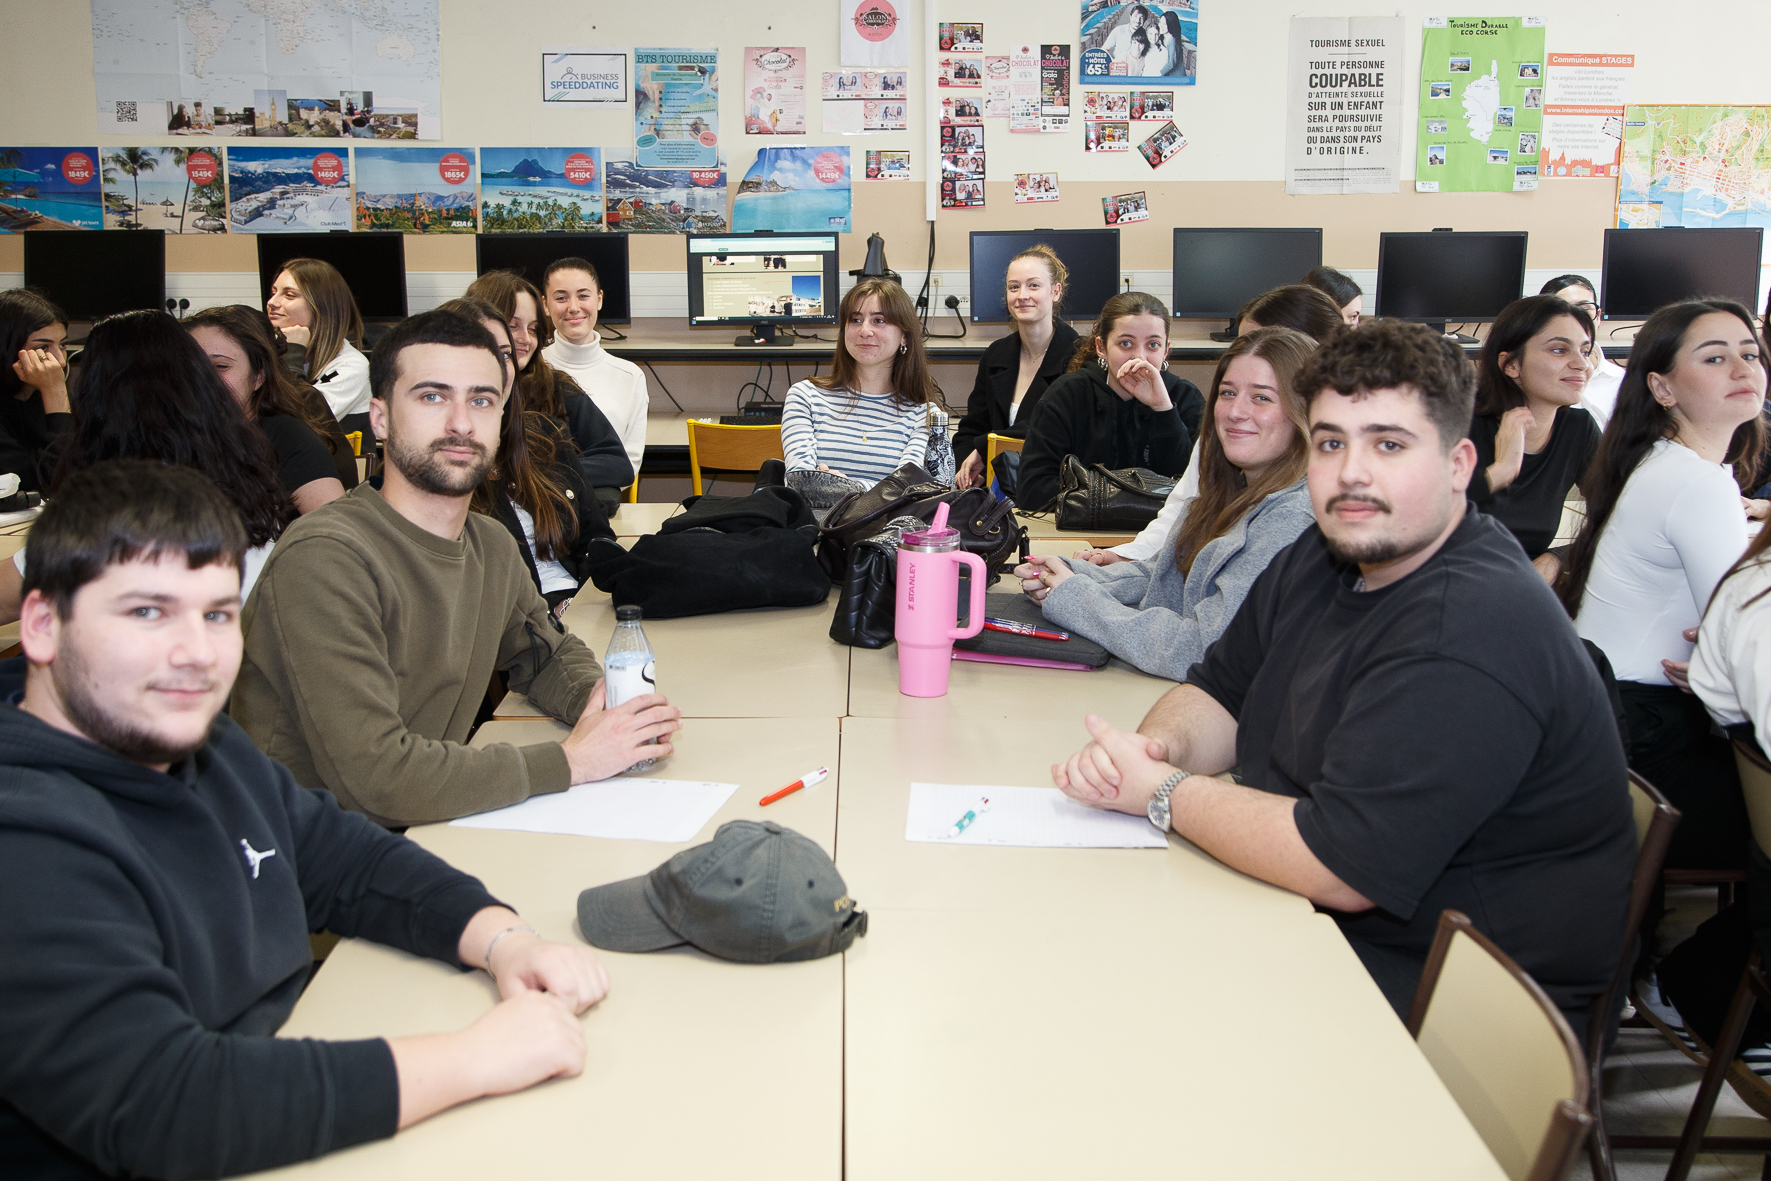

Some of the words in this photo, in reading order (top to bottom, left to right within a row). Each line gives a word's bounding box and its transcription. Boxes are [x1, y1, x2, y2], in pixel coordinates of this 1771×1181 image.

[637, 55, 657, 63] BTS
[660, 55, 716, 63] TOURISME
[763, 58, 788, 66] Chocolat
[1552, 56, 1600, 64] Communiqué
[1309, 61, 1336, 69] TOUTE
[1340, 61, 1385, 69] PERSONNE
[1309, 73, 1384, 88] COUPABLE
[550, 81, 618, 90] SPEEDDATING
[1308, 102, 1327, 111] SUR
[1330, 101, 1343, 110] UN
[1347, 101, 1384, 110] ENFANT
[1308, 115, 1329, 123] SERA
[1333, 114, 1383, 122] POURSUIVIE
[1364, 124, 1382, 132] DÉLIT
[1307, 136, 1317, 144] OU
[1361, 135, 1382, 143] PAYS
[1307, 146, 1369, 155] D'ORIGINE.
